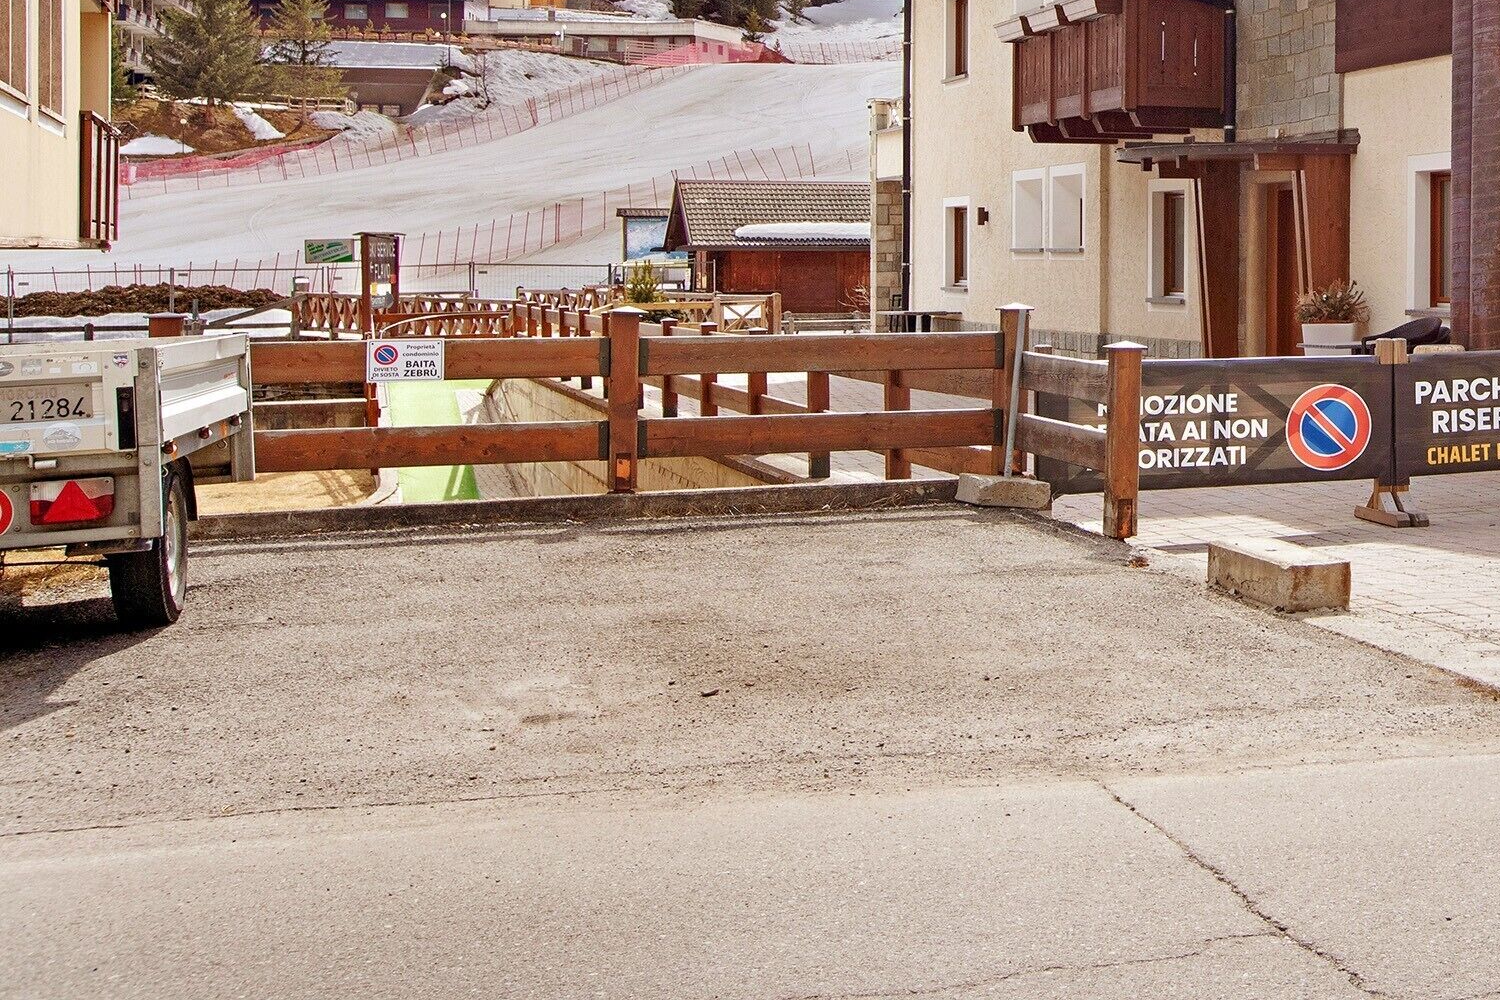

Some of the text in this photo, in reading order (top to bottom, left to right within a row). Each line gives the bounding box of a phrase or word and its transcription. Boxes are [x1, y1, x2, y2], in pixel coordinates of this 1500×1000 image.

[405, 360, 436, 368] BAITA
[10, 397, 85, 421] 21284
[1182, 421, 1207, 442] AI
[1213, 418, 1269, 440] NON
[1427, 443, 1491, 465] CHALET
